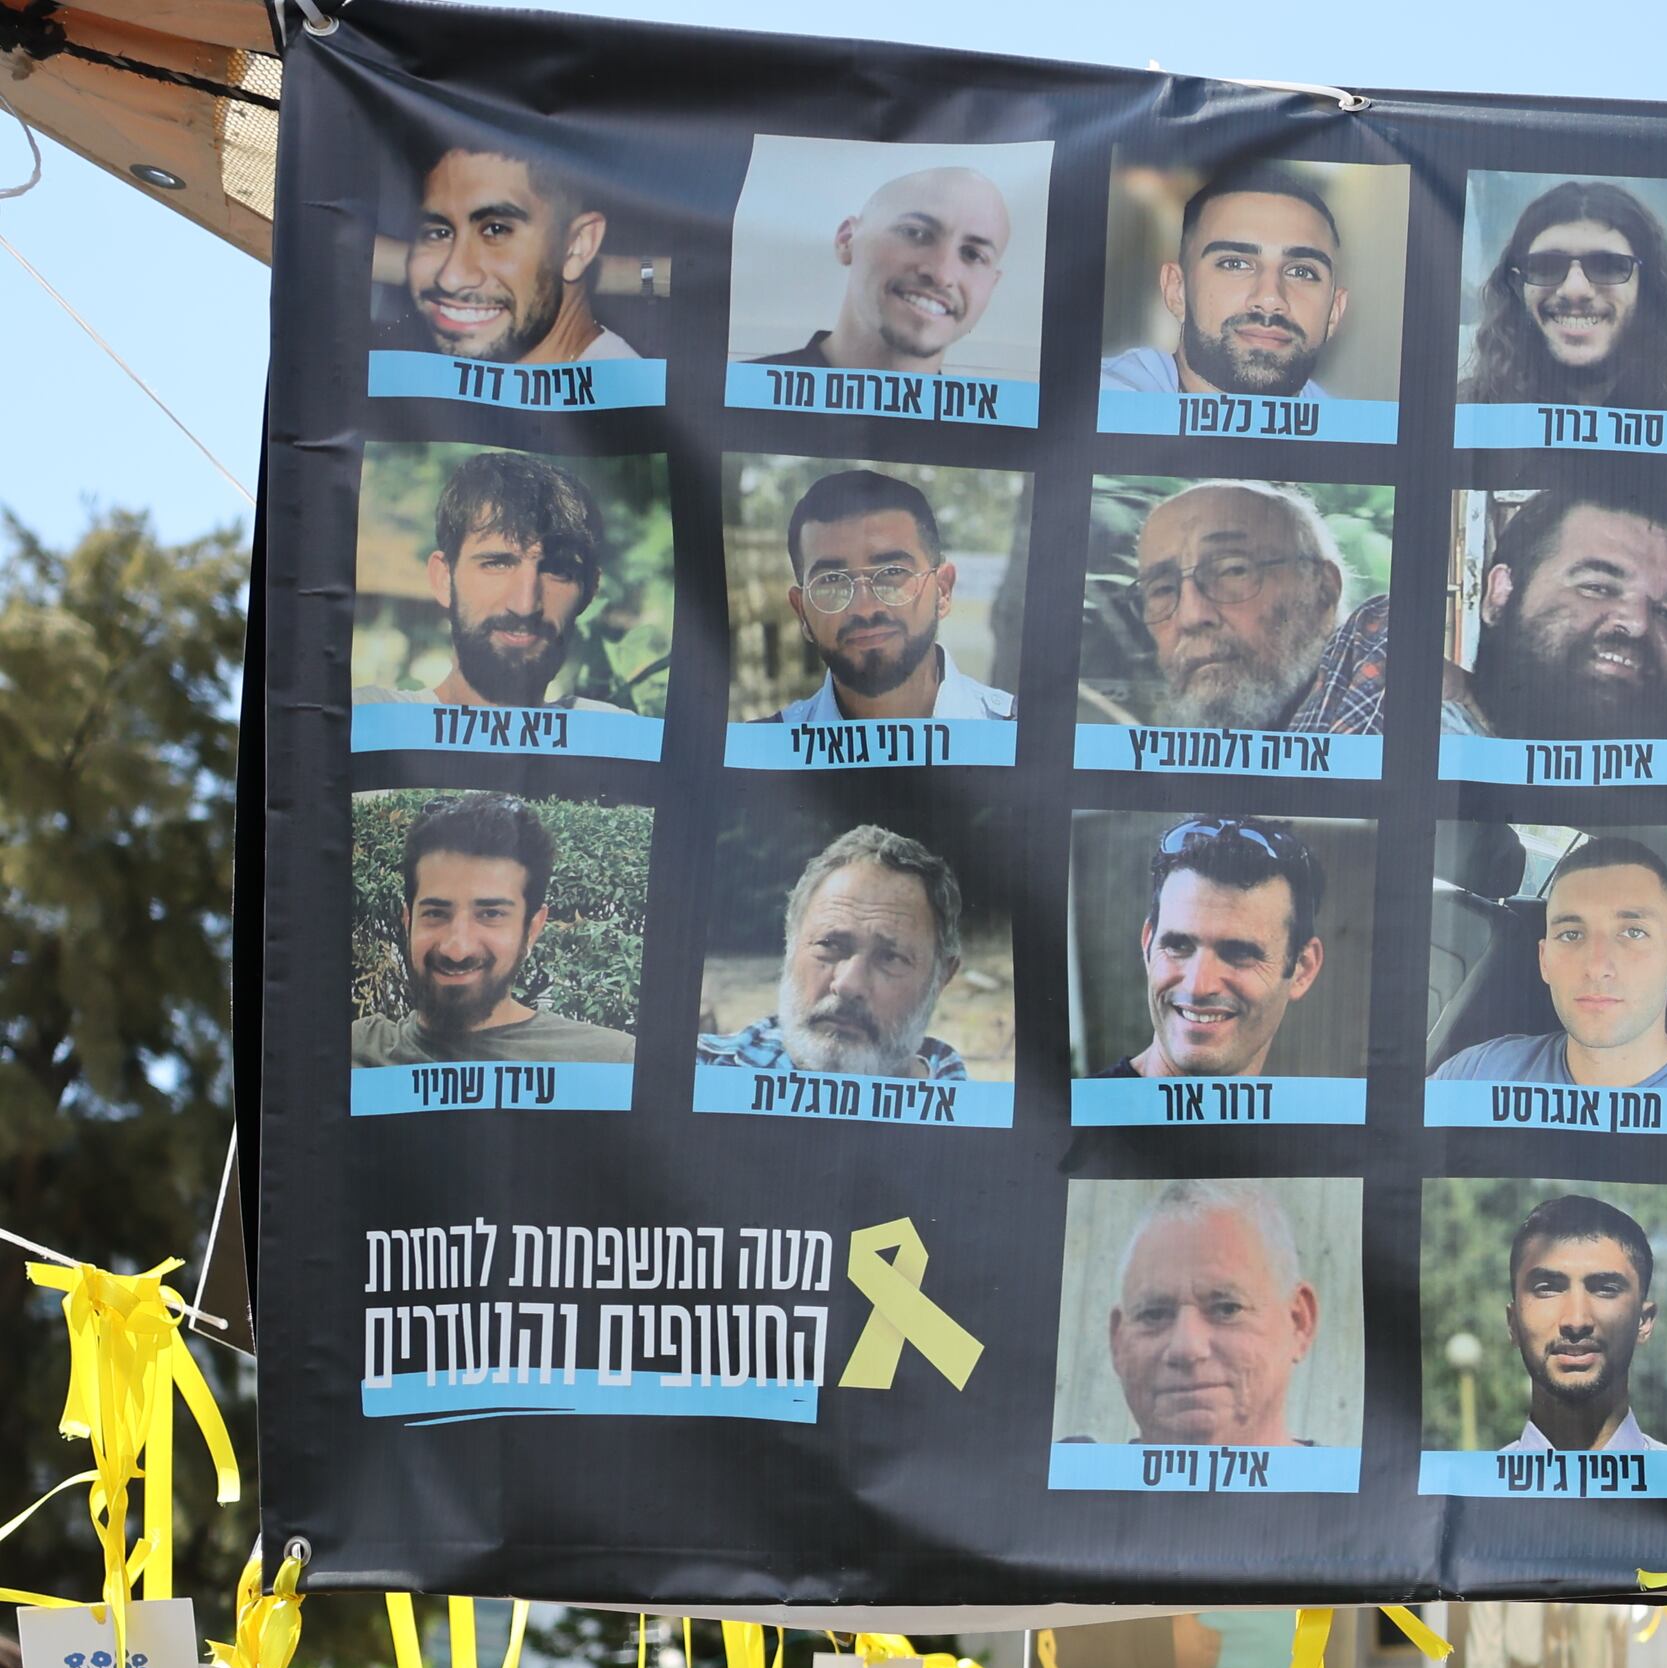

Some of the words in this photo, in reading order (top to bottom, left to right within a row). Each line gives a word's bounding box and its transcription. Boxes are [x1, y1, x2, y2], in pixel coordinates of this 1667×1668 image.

[453, 361, 505, 401] דוד
[513, 365, 596, 406] אביתר
[766, 369, 815, 408] מור
[825, 373, 923, 414] אברהם
[932, 379, 998, 420] איתן
[1178, 396, 1253, 436] כלפון
[1260, 400, 1319, 436] שגב
[1537, 407, 1598, 447] ברוך
[1607, 411, 1664, 447] סהר
[433, 706, 512, 747] אילוז
[519, 711, 568, 748] גיא
[790, 725, 869, 763] גואילי
[876, 726, 914, 764] רני
[923, 724, 951, 766] רן
[1128, 729, 1253, 771] זלמנוביץ
[1261, 734, 1331, 772] אריה
[1525, 744, 1582, 784] הורן
[1592, 743, 1653, 785] איתן
[411, 1066, 485, 1106] שתיוי
[494, 1066, 556, 1108] עידן
[751, 1074, 861, 1117] מרגלית
[871, 1080, 957, 1122] אליהו
[1158, 1083, 1205, 1121] אור
[1211, 1083, 1273, 1121] דרור
[1492, 1085, 1600, 1127] אנגרסט
[1609, 1090, 1662, 1134] מתן
[364, 1217, 497, 1293] להחזרת
[508, 1225, 722, 1290] המשפחות
[739, 1228, 833, 1292] מטה
[364, 1301, 578, 1389] והנעדרים
[598, 1305, 828, 1388] החטופים
[1142, 1450, 1198, 1486] וייס
[1208, 1447, 1269, 1491] אילן
[1496, 1451, 1568, 1492] ג'ושי
[1577, 1454, 1648, 1497] ביפין
